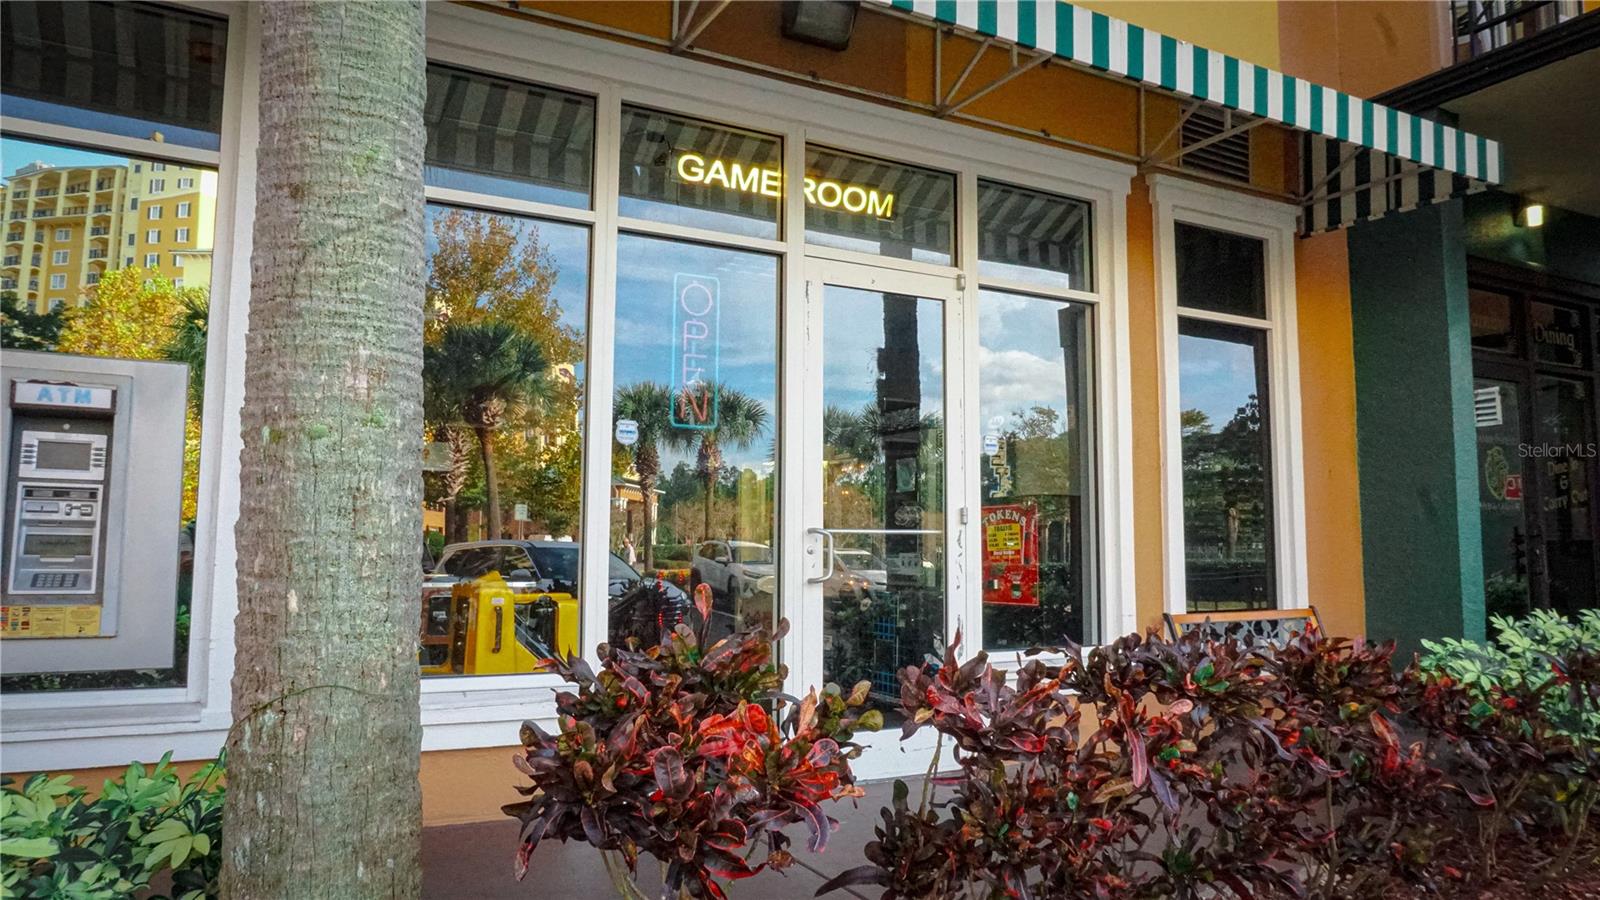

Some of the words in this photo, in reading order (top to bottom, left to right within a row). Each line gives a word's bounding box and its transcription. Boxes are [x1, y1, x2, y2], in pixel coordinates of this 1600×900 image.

[677, 154, 781, 197] GAME
[804, 177, 894, 218] ROOM
[1535, 324, 1576, 351] Dining
[679, 282, 713, 422] OPEN
[36, 386, 92, 405] ATM
[982, 509, 1027, 528] TOKENS
